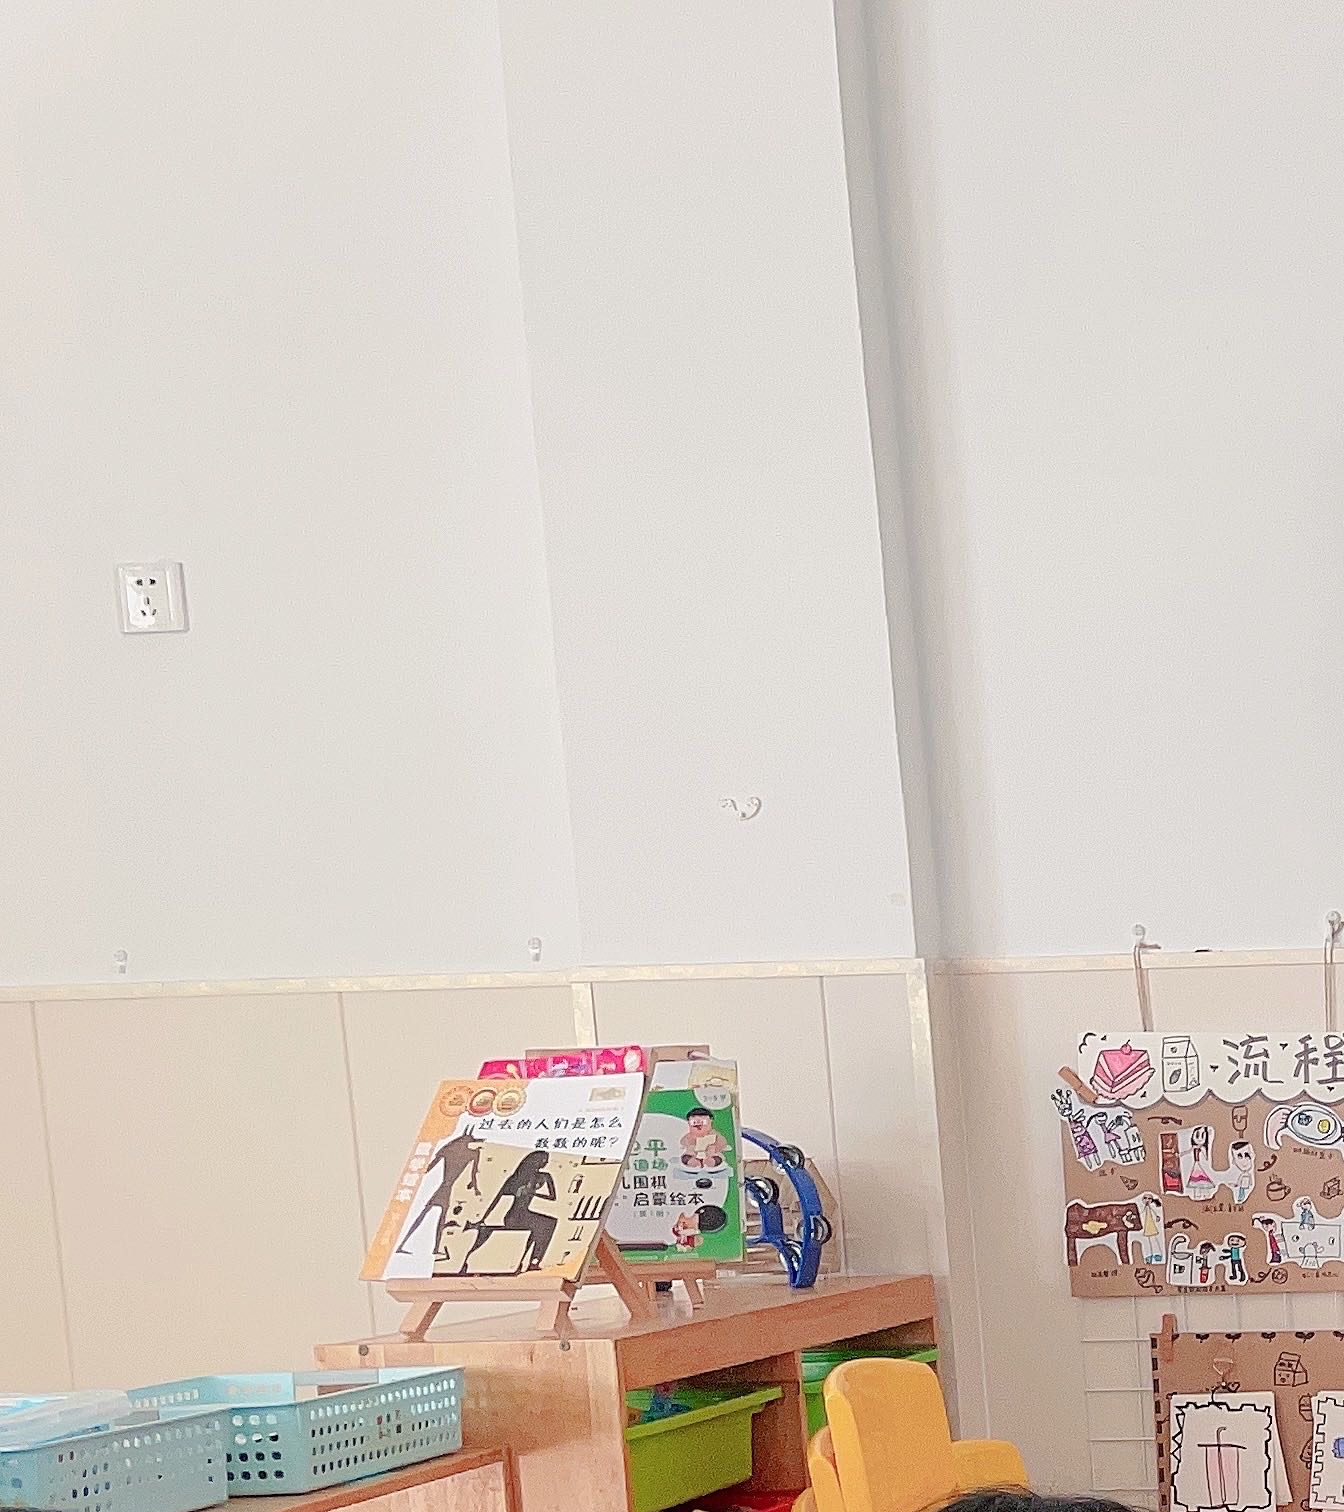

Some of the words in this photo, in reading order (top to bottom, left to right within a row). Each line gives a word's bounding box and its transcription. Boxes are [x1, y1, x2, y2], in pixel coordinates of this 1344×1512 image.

[478, 1116, 623, 1131] 过去的人们是怎么
[633, 1192, 705, 1207] 启蒙绘本
